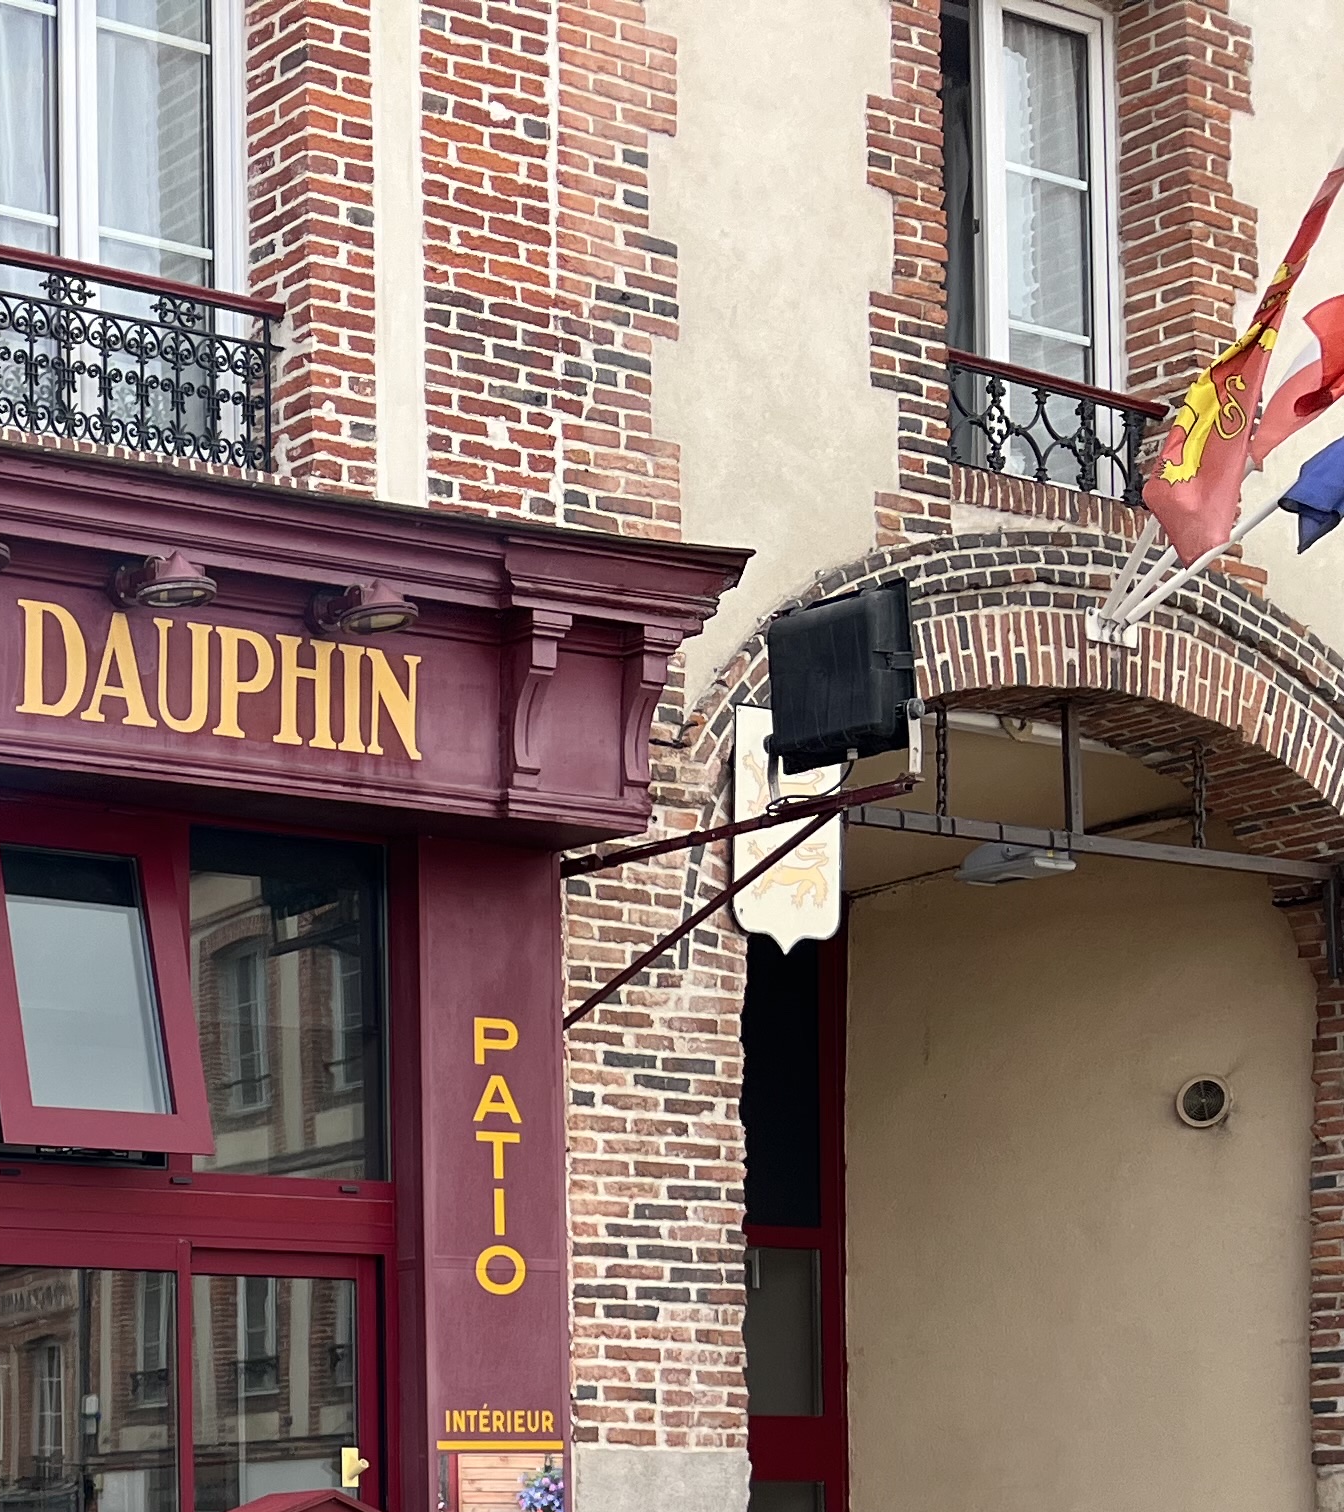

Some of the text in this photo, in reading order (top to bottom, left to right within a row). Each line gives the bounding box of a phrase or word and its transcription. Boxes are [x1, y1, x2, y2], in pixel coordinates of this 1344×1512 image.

[15, 597, 423, 761] DAUPHIN
[472, 1016, 527, 1296] PATIO
[444, 1403, 555, 1434] INTÉRIEUR
